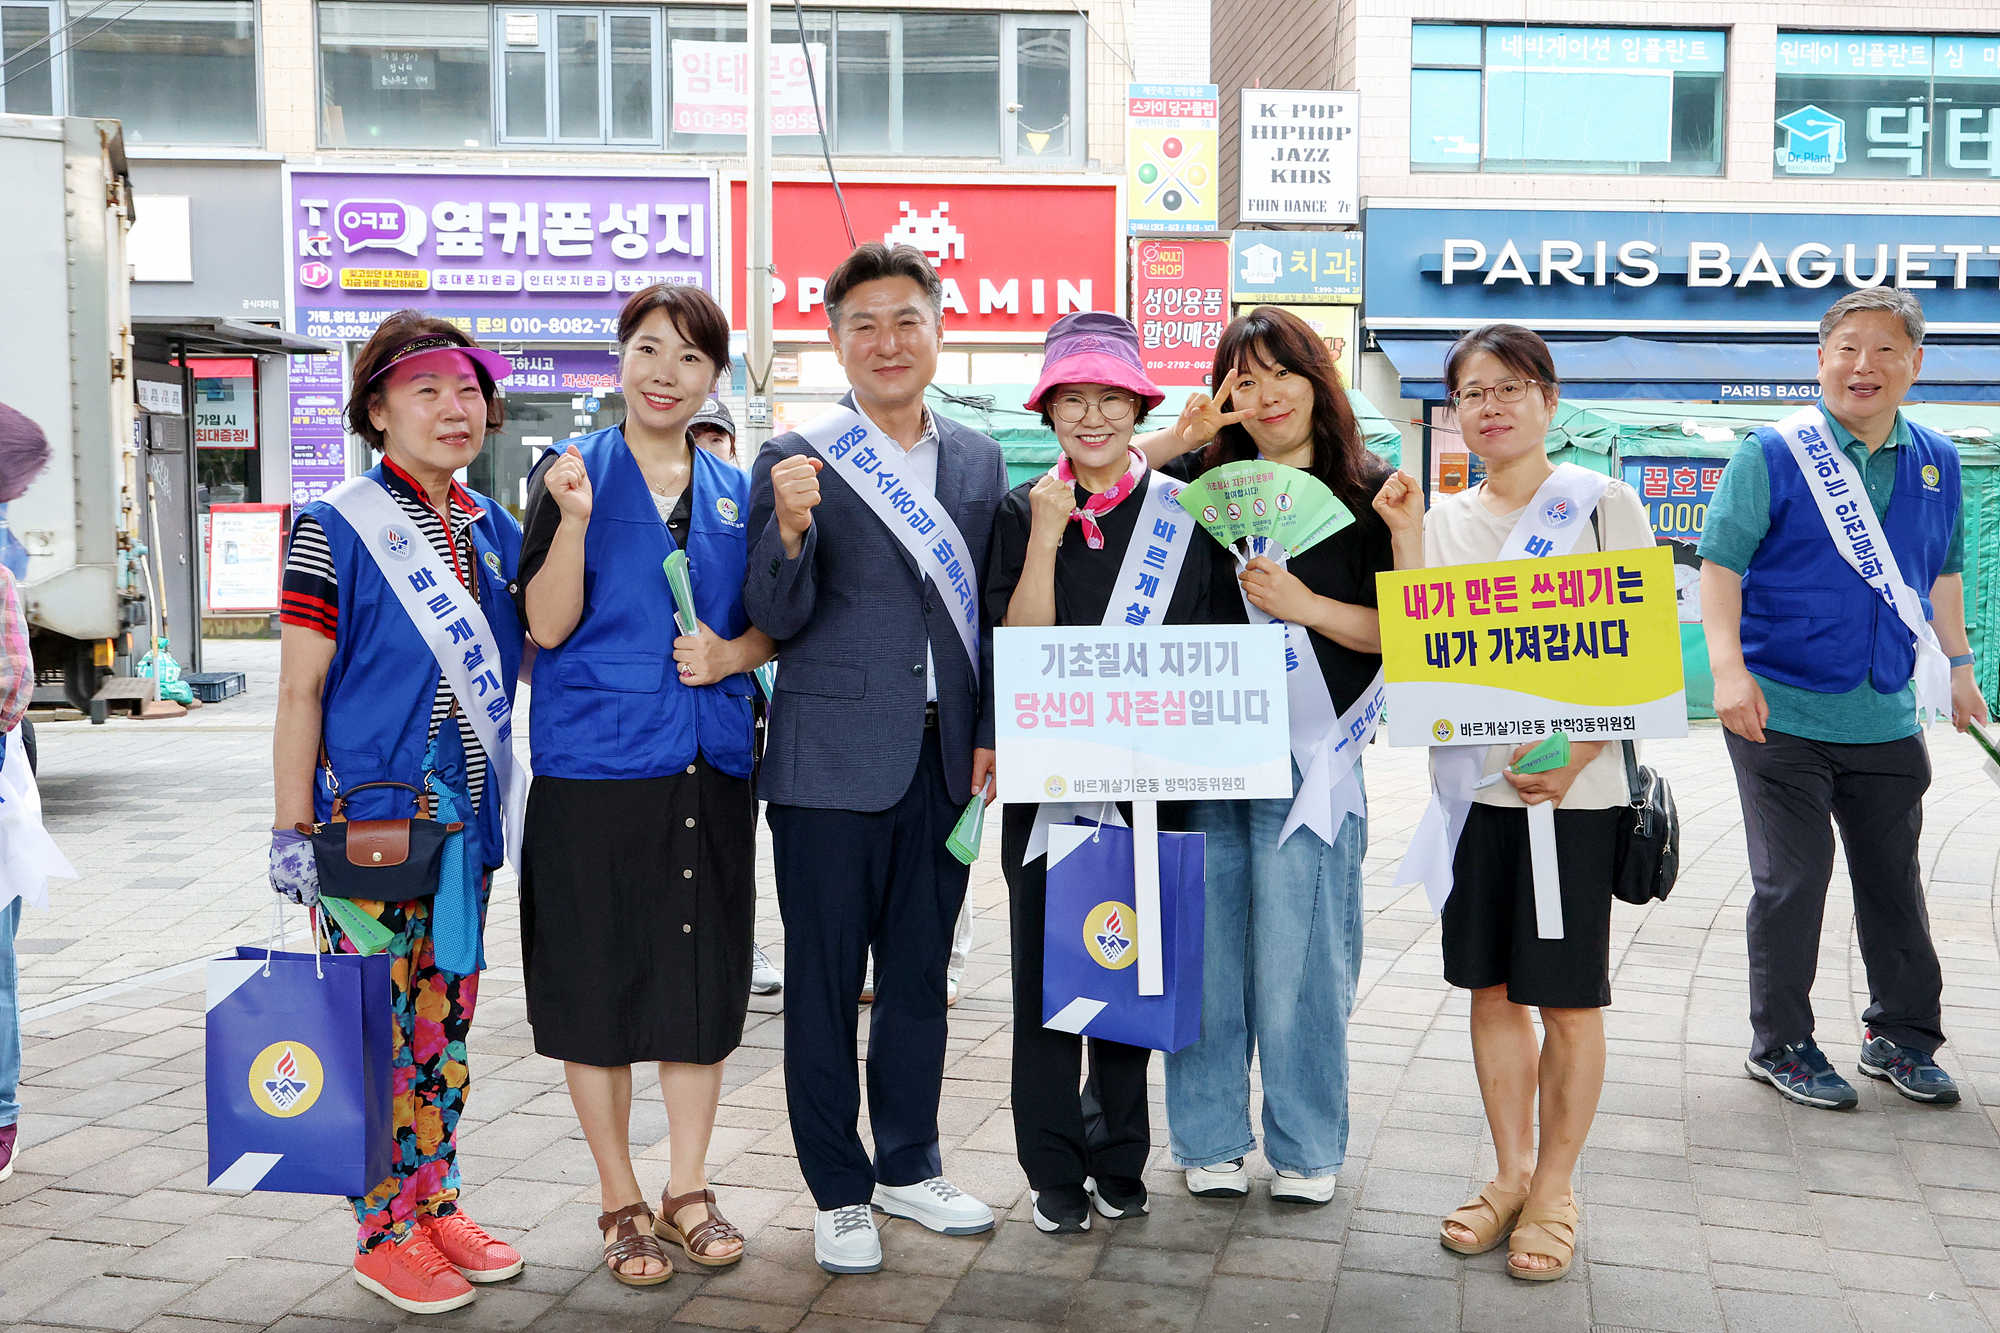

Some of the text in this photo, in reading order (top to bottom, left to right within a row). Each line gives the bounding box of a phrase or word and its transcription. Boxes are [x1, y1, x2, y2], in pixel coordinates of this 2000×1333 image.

[1501, 34, 1709, 63] 네비게이션 임플란트
[1779, 41, 1839, 66] 원데이
[1848, 42, 1929, 68] 임플란트
[1142, 86, 1203, 98] 깨끗하고 전망좋은
[1132, 100, 1214, 117] 스카이 당구클럽
[1259, 103, 1343, 119] K-POP
[1134, 118, 1164, 128] 새벽까지
[1165, 118, 1180, 128] 영업
[1250, 125, 1351, 141] HIPHOP
[1271, 147, 1330, 163] JAZZ
[1788, 151, 1832, 164] Dr.Plant
[1270, 169, 1331, 184] KIDS
[1248, 199, 1351, 213] FOIN DANCE 7F
[299, 229, 333, 257] kt
[1159, 251, 1182, 262] ADULT
[1442, 238, 1660, 288] PARIS
[1150, 264, 1182, 275] SHOP
[1290, 248, 1357, 283] 치과
[349, 269, 419, 279] 잊고있던 내 지원금
[345, 279, 424, 288] 지금 바로 확인하세요
[1313, 286, 1350, 294] T.999-2804
[242, 299, 279, 310] 공식대리점
[1142, 287, 1223, 317] 성인용품
[476, 317, 507, 333] 문의
[1142, 319, 1224, 350] 할인매장
[1721, 385, 1770, 397] PARIS
[197, 414, 236, 426] 가입 시
[195, 428, 249, 442] 최대증정!
[828, 425, 868, 461] 2025
[1233, 475, 1255, 487] 지키기
[851, 446, 937, 536] 탄소중립
[1798, 425, 1884, 581] 실천하는 안전문화
[1403, 566, 1644, 620] 내가 만든 쓰레기는
[1424, 619, 1630, 668] 내가 가져갑시다
[1041, 641, 1239, 679] 기초질서 지키기
[1014, 689, 1270, 729] 당신의 자존심입니다
[1460, 715, 1636, 737] 바르게살기운동 방학3동위원회
[1074, 776, 1245, 794] 바르게살기운동 방학3동위원회
